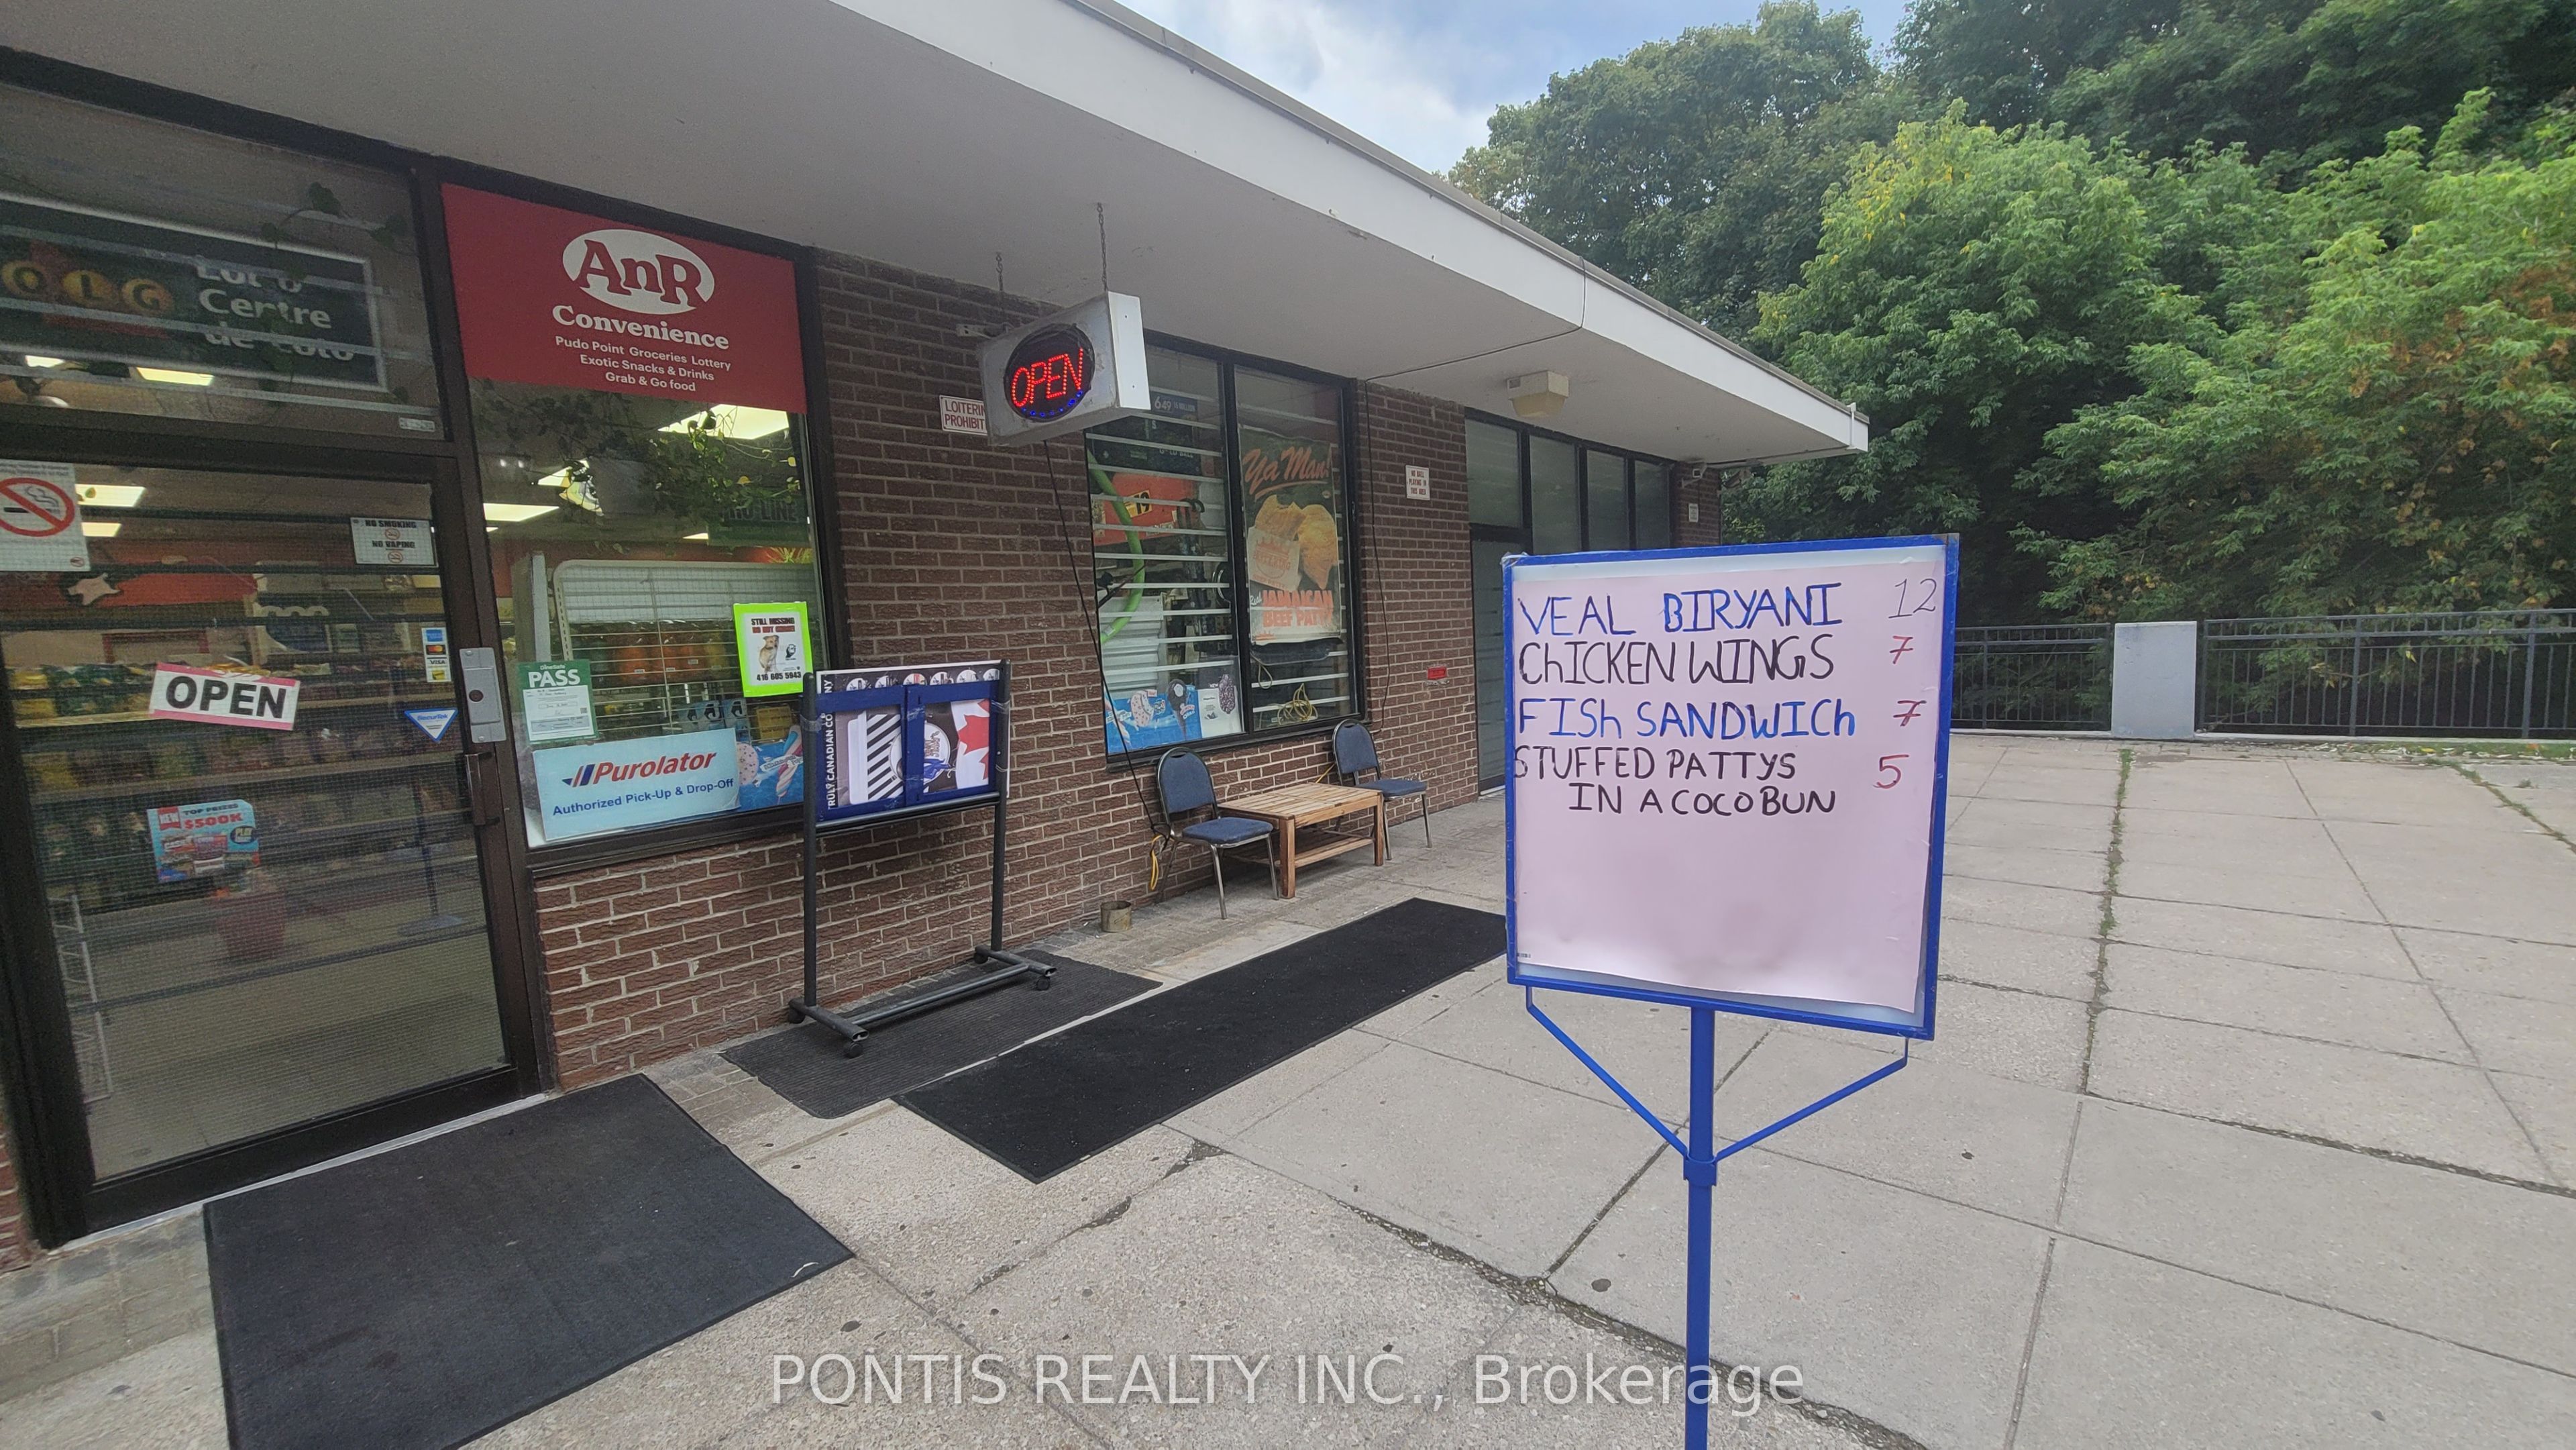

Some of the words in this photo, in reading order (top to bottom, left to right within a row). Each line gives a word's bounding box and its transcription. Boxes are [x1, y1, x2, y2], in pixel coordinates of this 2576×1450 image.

[13, 268, 160, 309] OLG
[197, 256, 302, 293] Loto
[575, 239, 706, 309] AnR
[552, 305, 729, 350] Convenience
[555, 335, 589, 350] Pudo
[592, 341, 625, 355] Point
[629, 346, 688, 364] Groceries
[692, 356, 731, 371] Lottery
[580, 354, 619, 368] Exotic
[622, 360, 665, 374] Snacks
[667, 366, 676, 376] &
[679, 368, 714, 380] Drinks
[606, 372, 635, 384] Grab
[639, 376, 647, 386] &
[651, 378, 667, 388] Go
[669, 380, 696, 391] food
[1011, 347, 1083, 408] OPEN
[945, 413, 985, 430] PROHIBIT
[1242, 448, 1280, 495] Ya
[365, 519, 376, 527] NO
[378, 520, 417, 529] SMOKING
[1263, 590, 1334, 609] JAMAICAN
[1517, 594, 1637, 635] VEAL
[1663, 582, 1843, 633] BIRYANI
[1888, 578, 1937, 619] 12
[1263, 609, 1293, 627] BEEF
[1688, 633, 1834, 684] WINGS
[1889, 635, 1913, 664] 7
[528, 669, 581, 688] PASS
[757, 673, 769, 681] 416
[166, 676, 286, 719] OPEN
[1893, 700, 1927, 727] 7
[593, 752, 716, 784] Purolator
[826, 729, 837, 781] CANADIAN
[1513, 745, 1655, 779] STUFFED
[1874, 754, 1909, 789] 5
[553, 796, 622, 816] Authorized
[626, 789, 672, 806] Pick-Up
[675, 786, 684, 795] &
[687, 778, 734, 794] Drop-Off
[1568, 783, 1621, 814] IN
[184, 813, 243, 830] $500K
